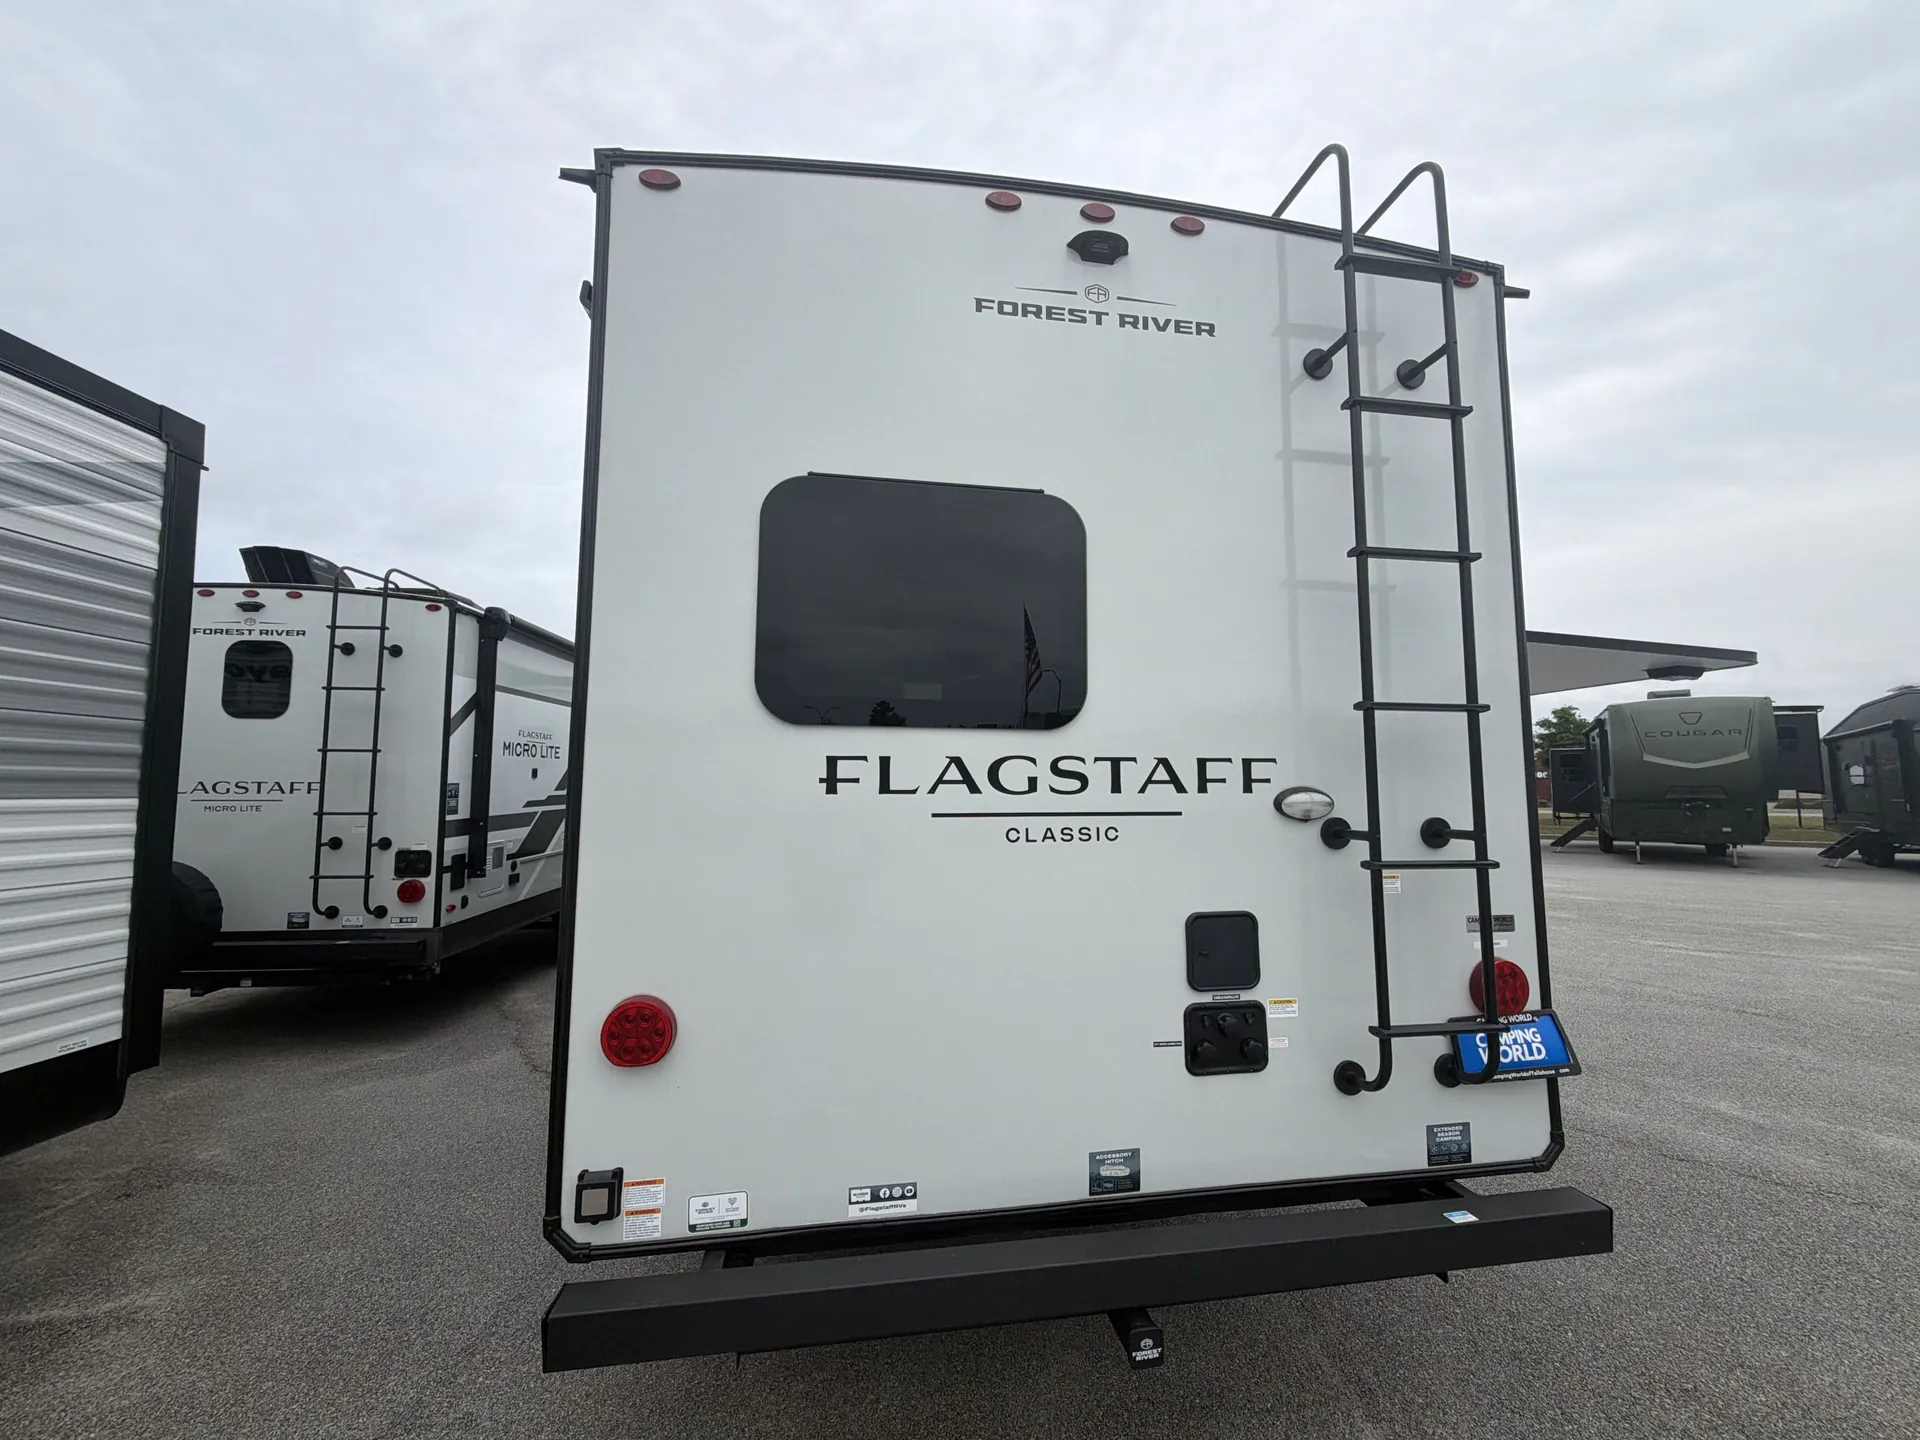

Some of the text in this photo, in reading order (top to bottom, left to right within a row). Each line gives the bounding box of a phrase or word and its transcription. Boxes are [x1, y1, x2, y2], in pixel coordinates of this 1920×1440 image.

[973, 297, 1217, 338] FOREST RIVER
[192, 627, 307, 637] FOREST RIVER
[518, 729, 553, 740] FLAGSTAFF
[1644, 728, 1743, 738] COUGAR
[502, 741, 561, 759] MICRO LITE
[819, 755, 1278, 795] FLAGSTAFF
[176, 780, 321, 795] AGSTAFF
[1005, 827, 1120, 844] CLASSIC
[1507, 1013, 1533, 1023] WORLD
[1475, 1027, 1542, 1048] CMPING
[1433, 1125, 1464, 1133] EXTENDED
[1095, 1151, 1132, 1160] ACCESSORY
[1132, 1347, 1163, 1358] FOREST
[1135, 1353, 1159, 1361] RIVER
